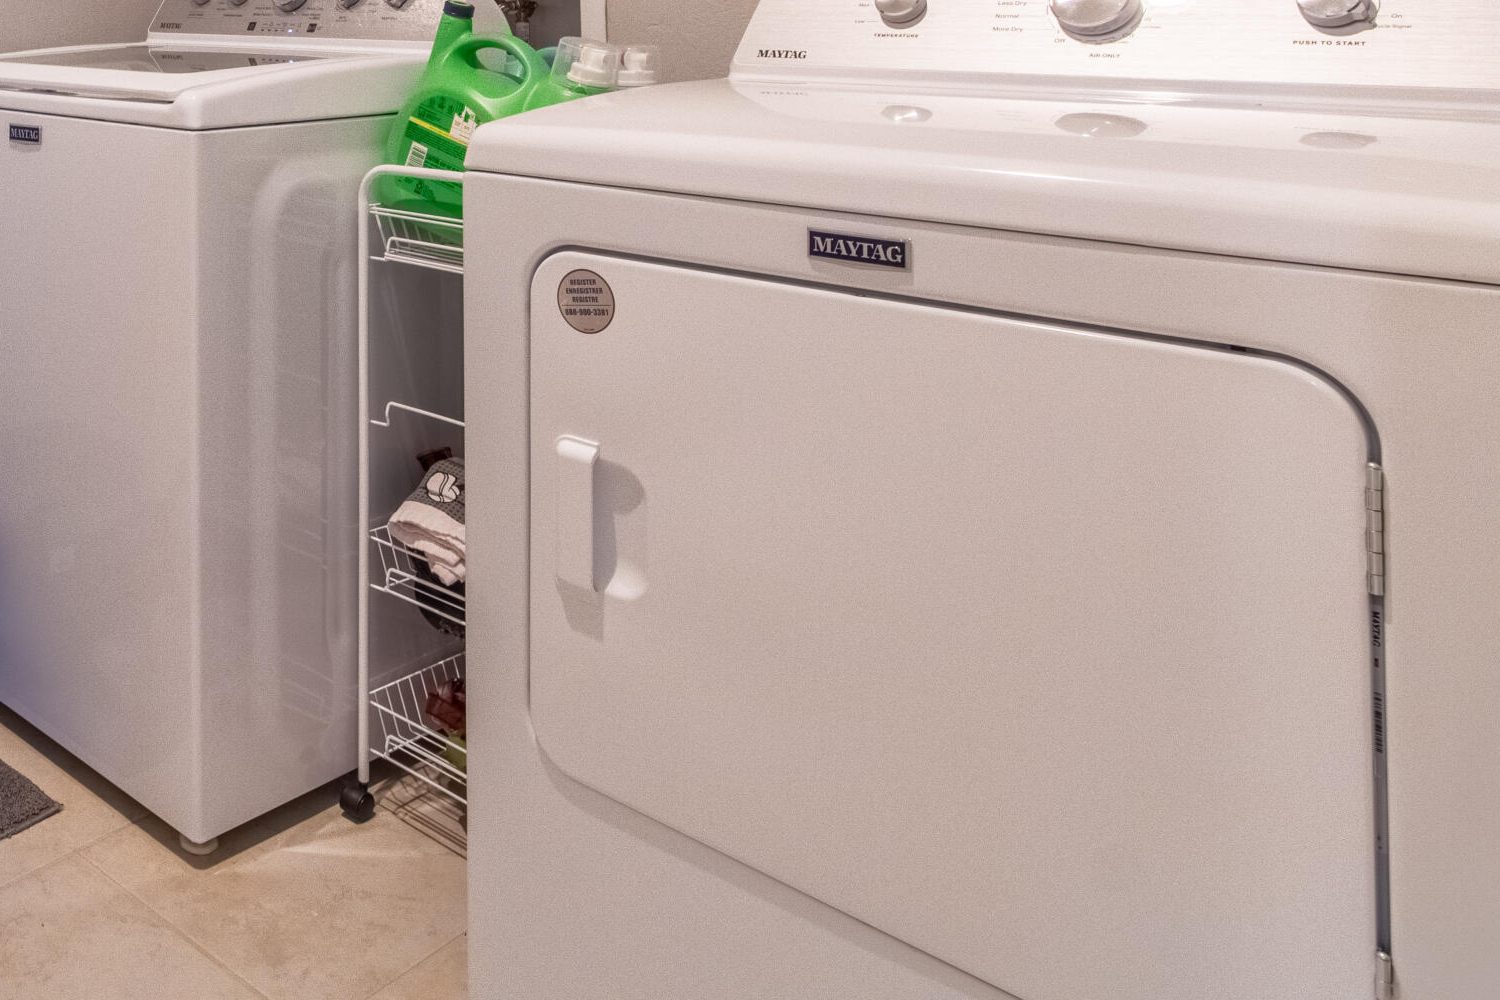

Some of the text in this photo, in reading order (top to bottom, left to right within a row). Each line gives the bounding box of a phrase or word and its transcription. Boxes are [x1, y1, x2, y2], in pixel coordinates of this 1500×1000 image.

[756, 49, 808, 60] MAYTAG
[10, 127, 39, 140] MAYTAG
[812, 236, 904, 263] MAYTAG
